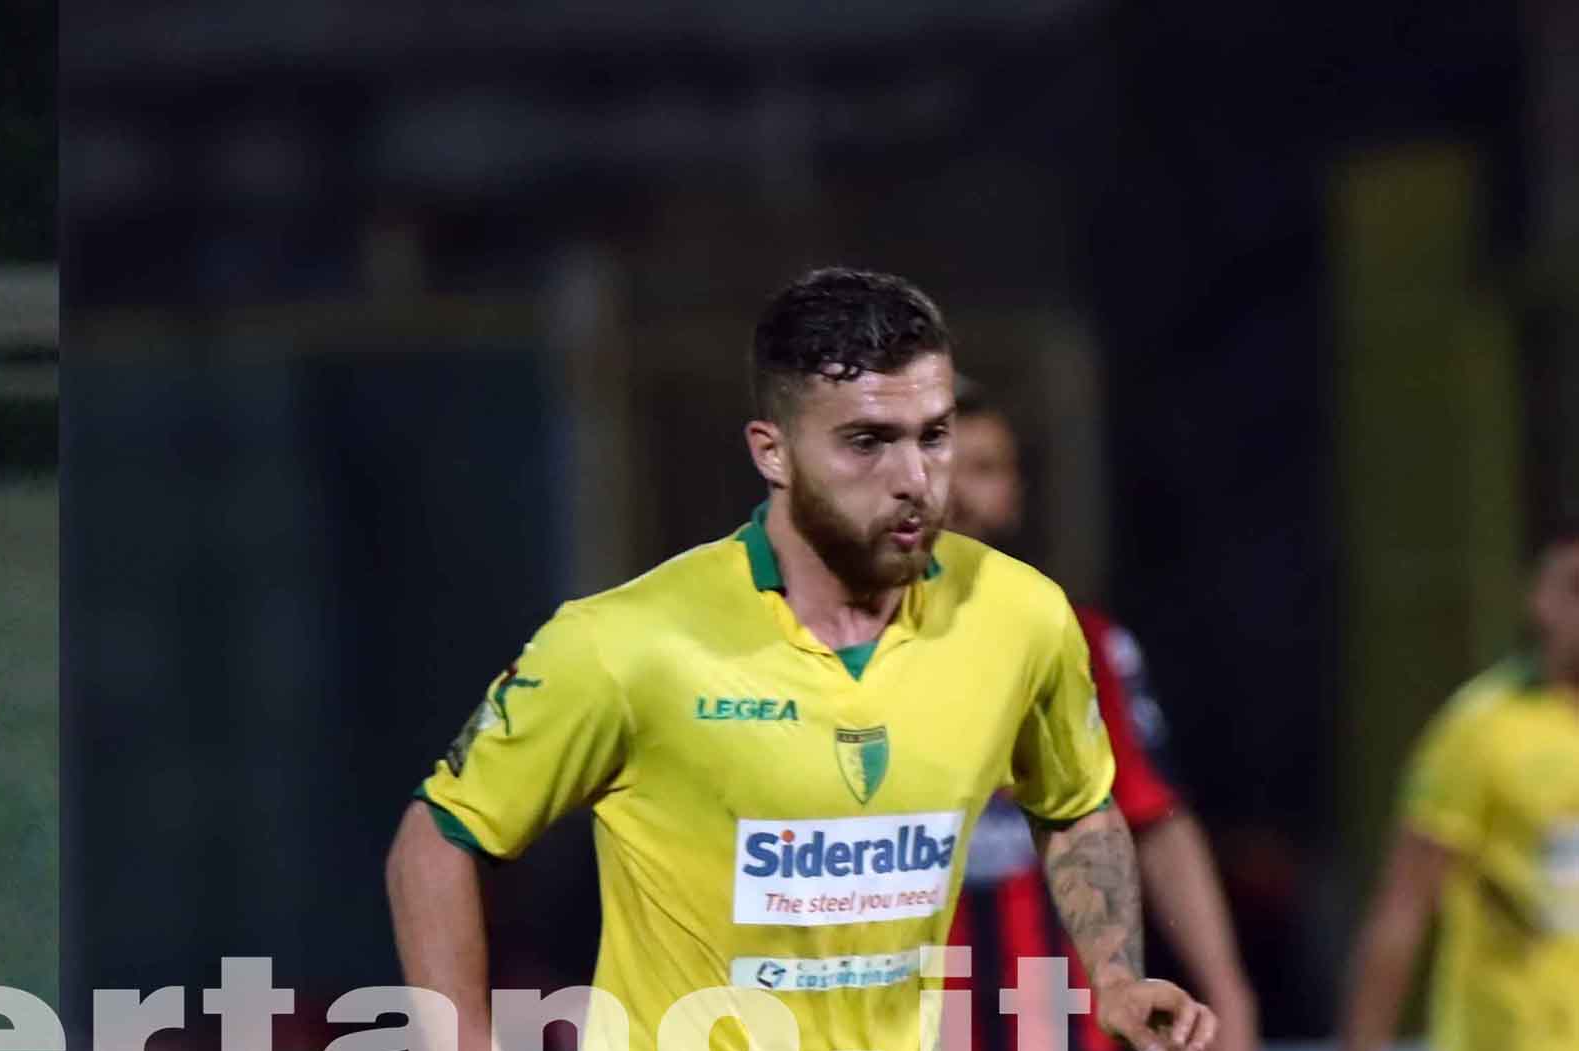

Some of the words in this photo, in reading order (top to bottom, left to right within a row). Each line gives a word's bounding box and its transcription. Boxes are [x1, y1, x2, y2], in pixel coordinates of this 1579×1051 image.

[696, 698, 799, 721] LEGEA
[765, 892, 803, 913] The
[808, 891, 855, 912] steel
[857, 893, 895, 915] you
